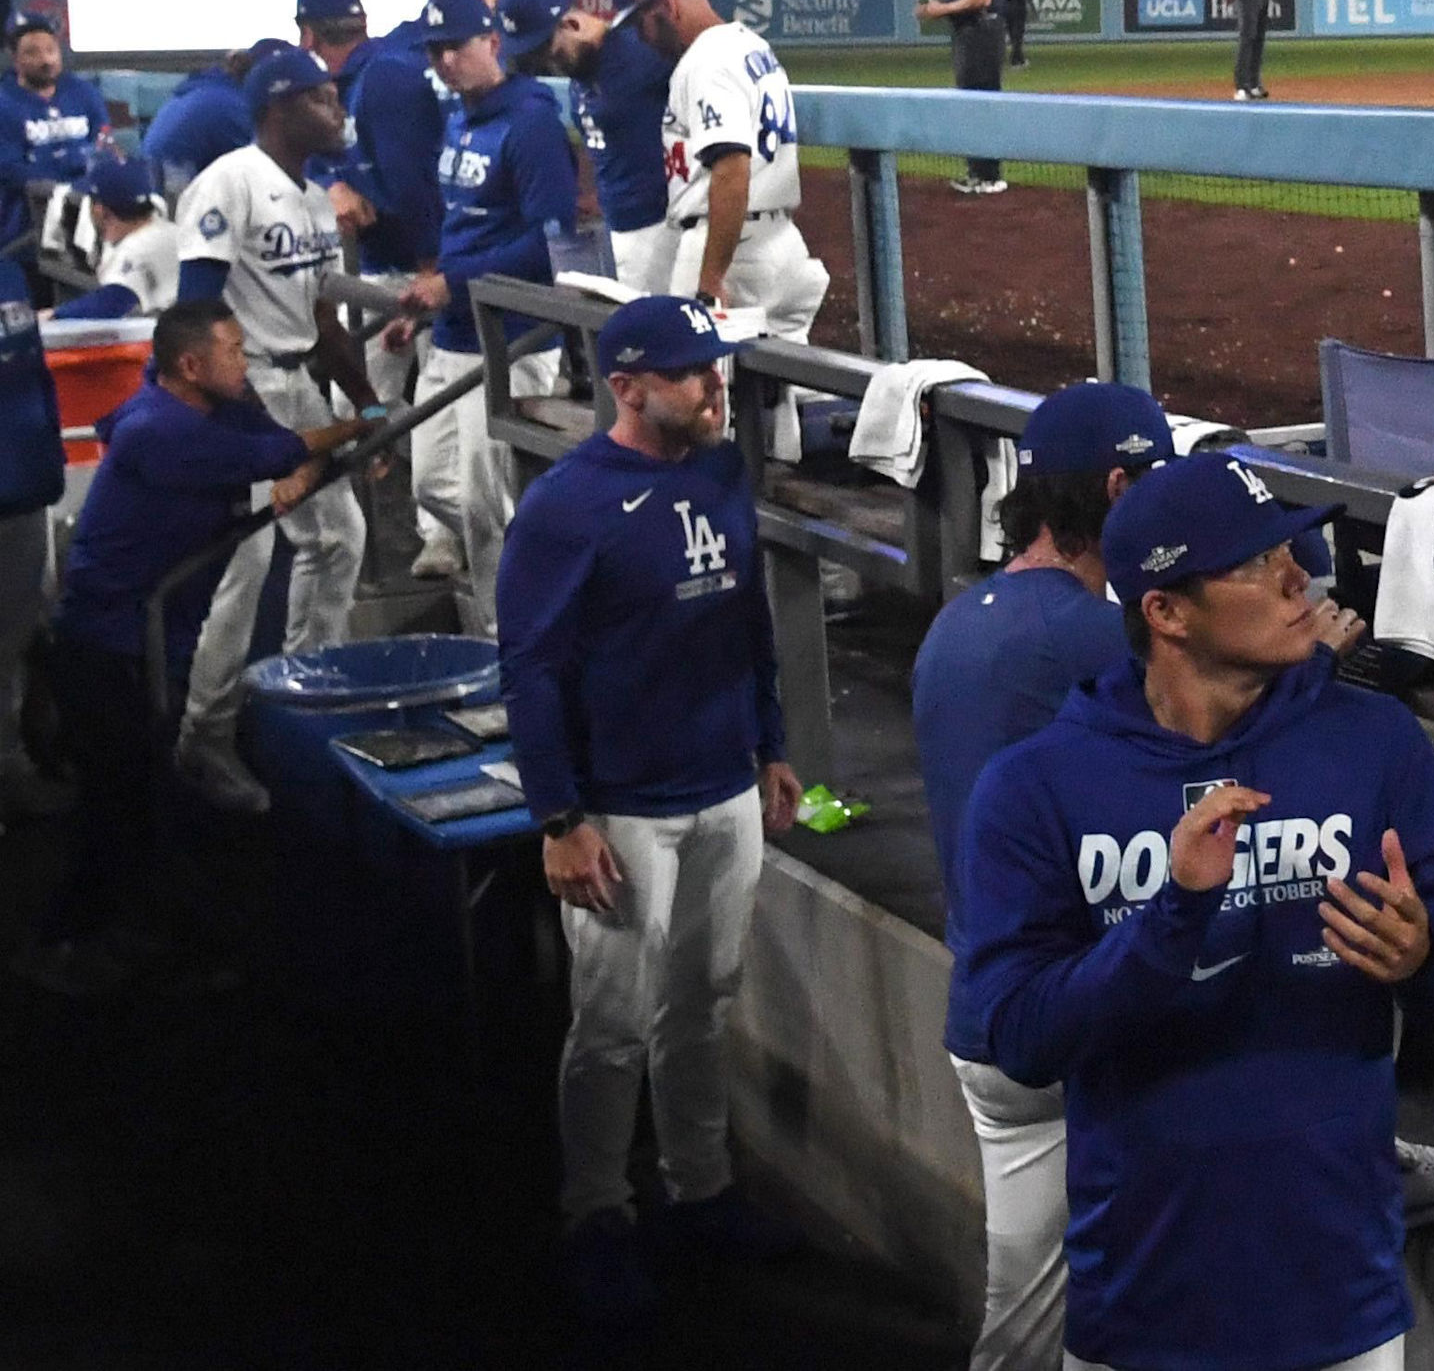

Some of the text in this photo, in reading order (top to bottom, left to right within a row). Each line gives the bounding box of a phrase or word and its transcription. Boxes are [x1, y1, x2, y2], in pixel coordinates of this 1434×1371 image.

[782, 12, 851, 35] Benefit
[698, 99, 723, 130] LA
[681, 304, 712, 334] LA
[1227, 460, 1274, 505] LA
[673, 500, 727, 576] LA
[1078, 813, 1353, 905] DOGERS
[1234, 880, 1325, 909] OCTOBER
